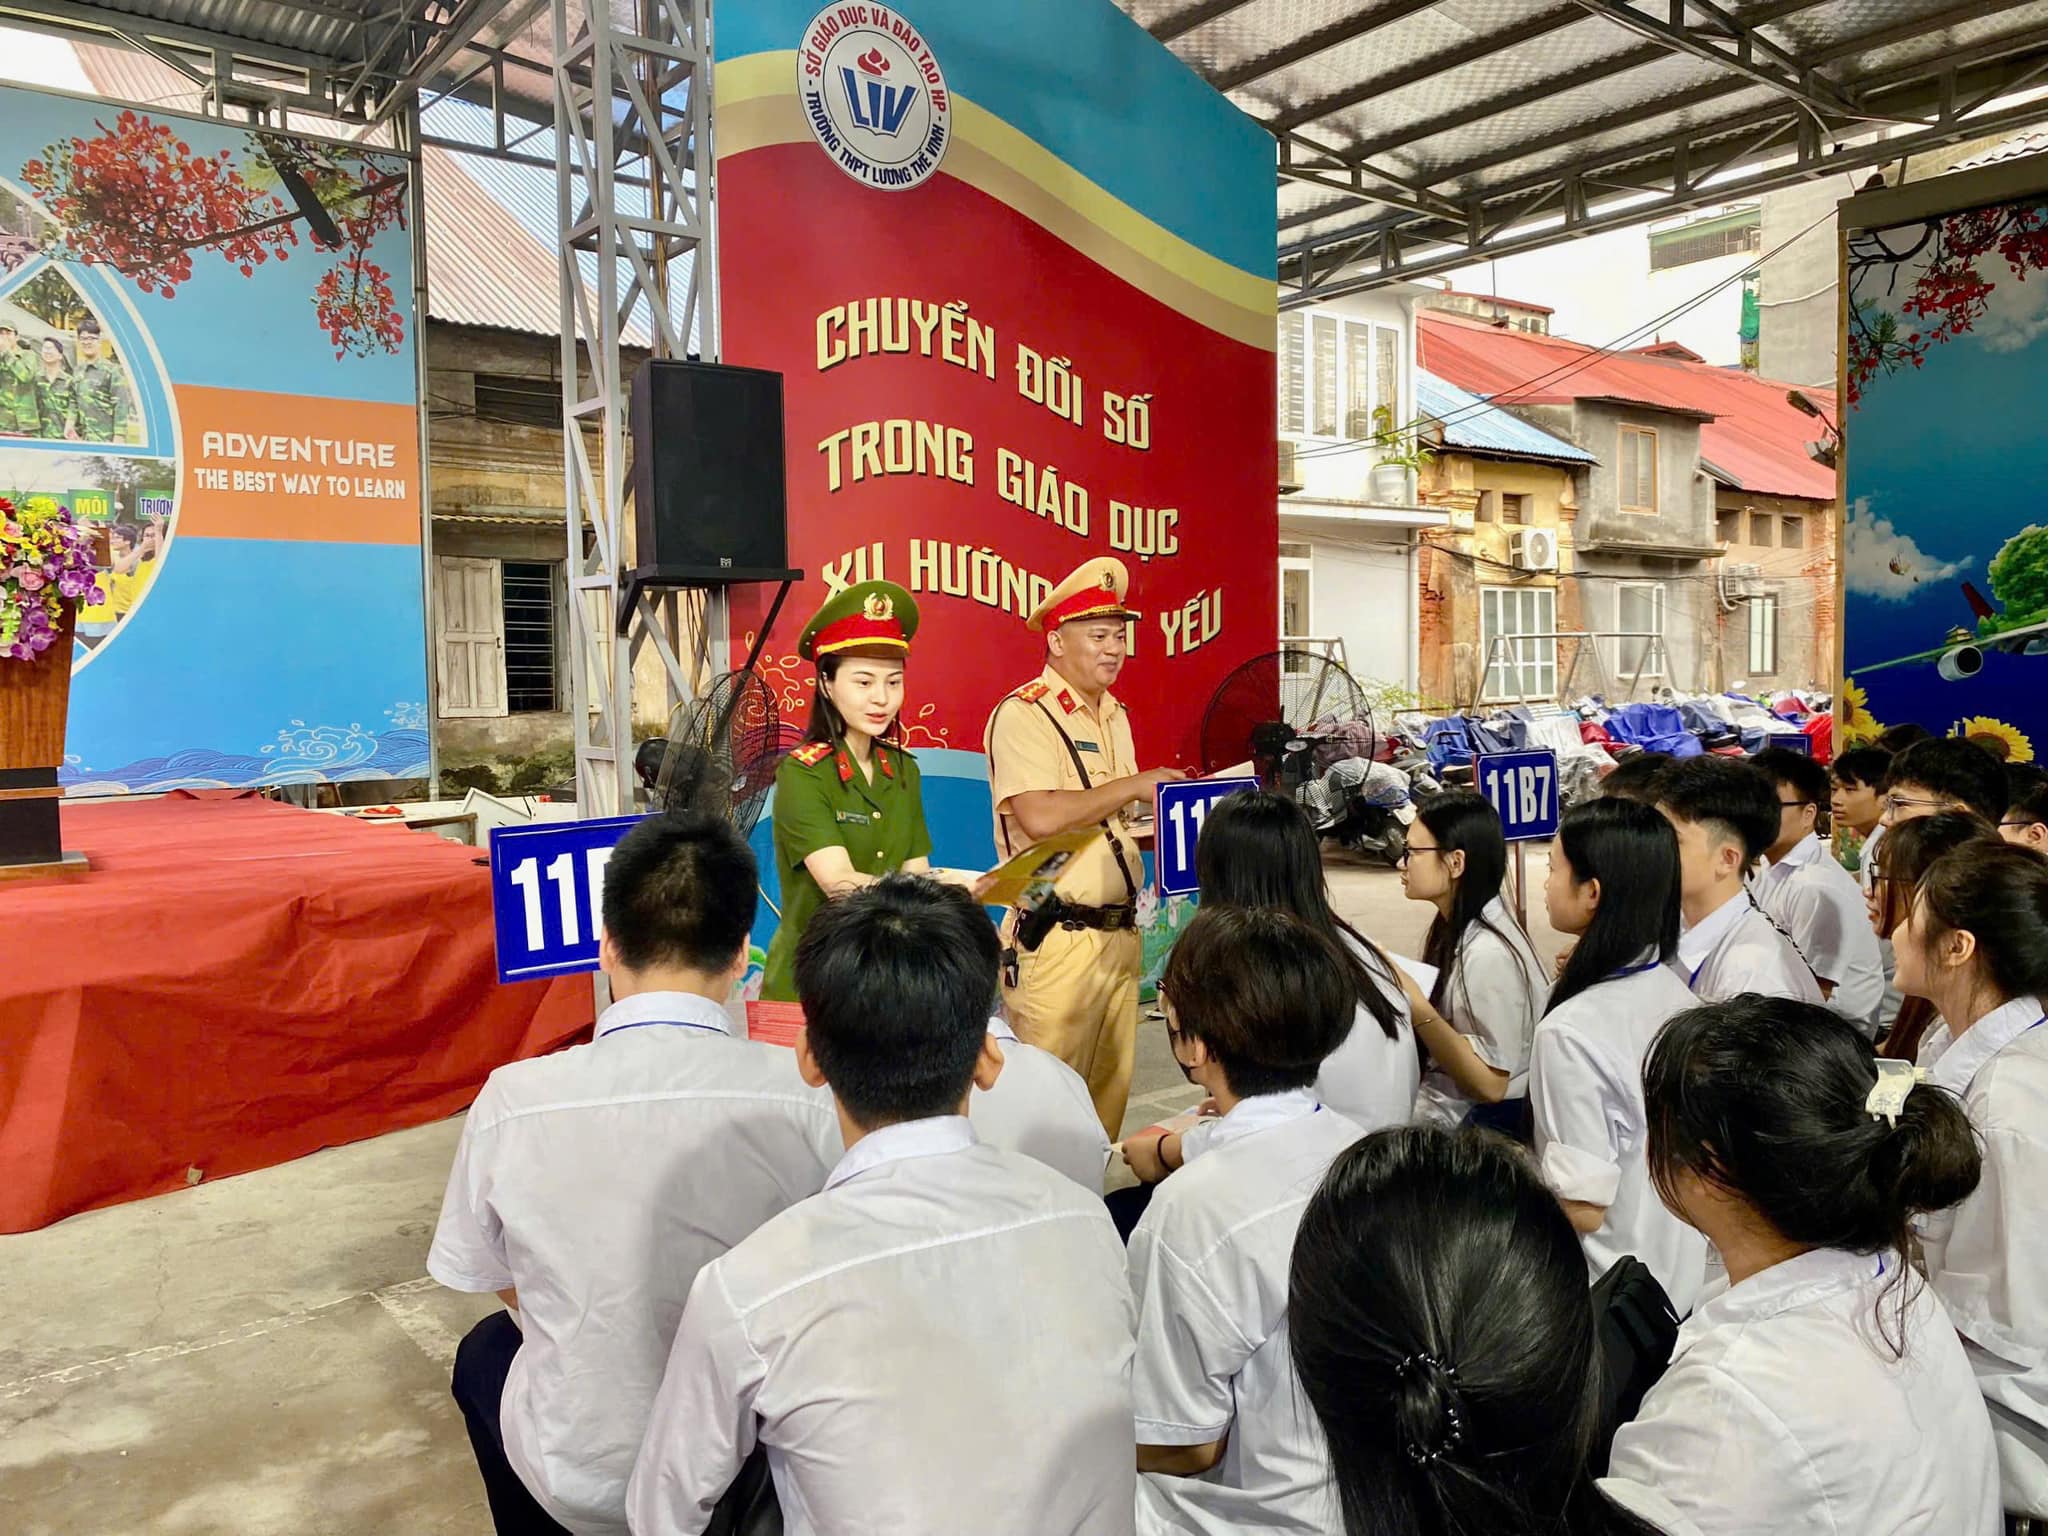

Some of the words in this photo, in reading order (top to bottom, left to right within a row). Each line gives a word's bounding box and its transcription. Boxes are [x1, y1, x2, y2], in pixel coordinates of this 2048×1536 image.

[801, 50, 822, 77] SỞ
[812, 16, 841, 51] GIÁO
[838, 6, 867, 29] DỤC
[871, 8, 889, 30] VÀ
[892, 20, 920, 52] ĐÀO
[918, 50, 940, 85] TẠO
[931, 89, 946, 113] HP
[806, 91, 841, 153] TRƯỜNG
[839, 147, 870, 178] THPT
[872, 166, 912, 186] LƯƠNG
[910, 150, 932, 177] THẾ
[925, 124, 945, 158] VINH
[816, 297, 995, 380] CHUYỂN
[1015, 343, 1083, 426] ĐỔI
[1103, 390, 1153, 449] SỐ
[194, 467, 229, 490] THE
[233, 470, 276, 493] BEST
[281, 473, 321, 495] WAY
[326, 476, 350, 497] TO
[355, 477, 405, 499] LEARN
[202, 431, 396, 469] ADVENTURE
[75, 496, 109, 515] MÔI
[818, 419, 975, 492] TRONG
[997, 447, 1089, 536] GIÁO
[1109, 499, 1178, 561] DỤC
[1160, 588, 1221, 656] YẾU
[1486, 766, 1551, 824] 11B7
[1169, 796, 1224, 871] 11
